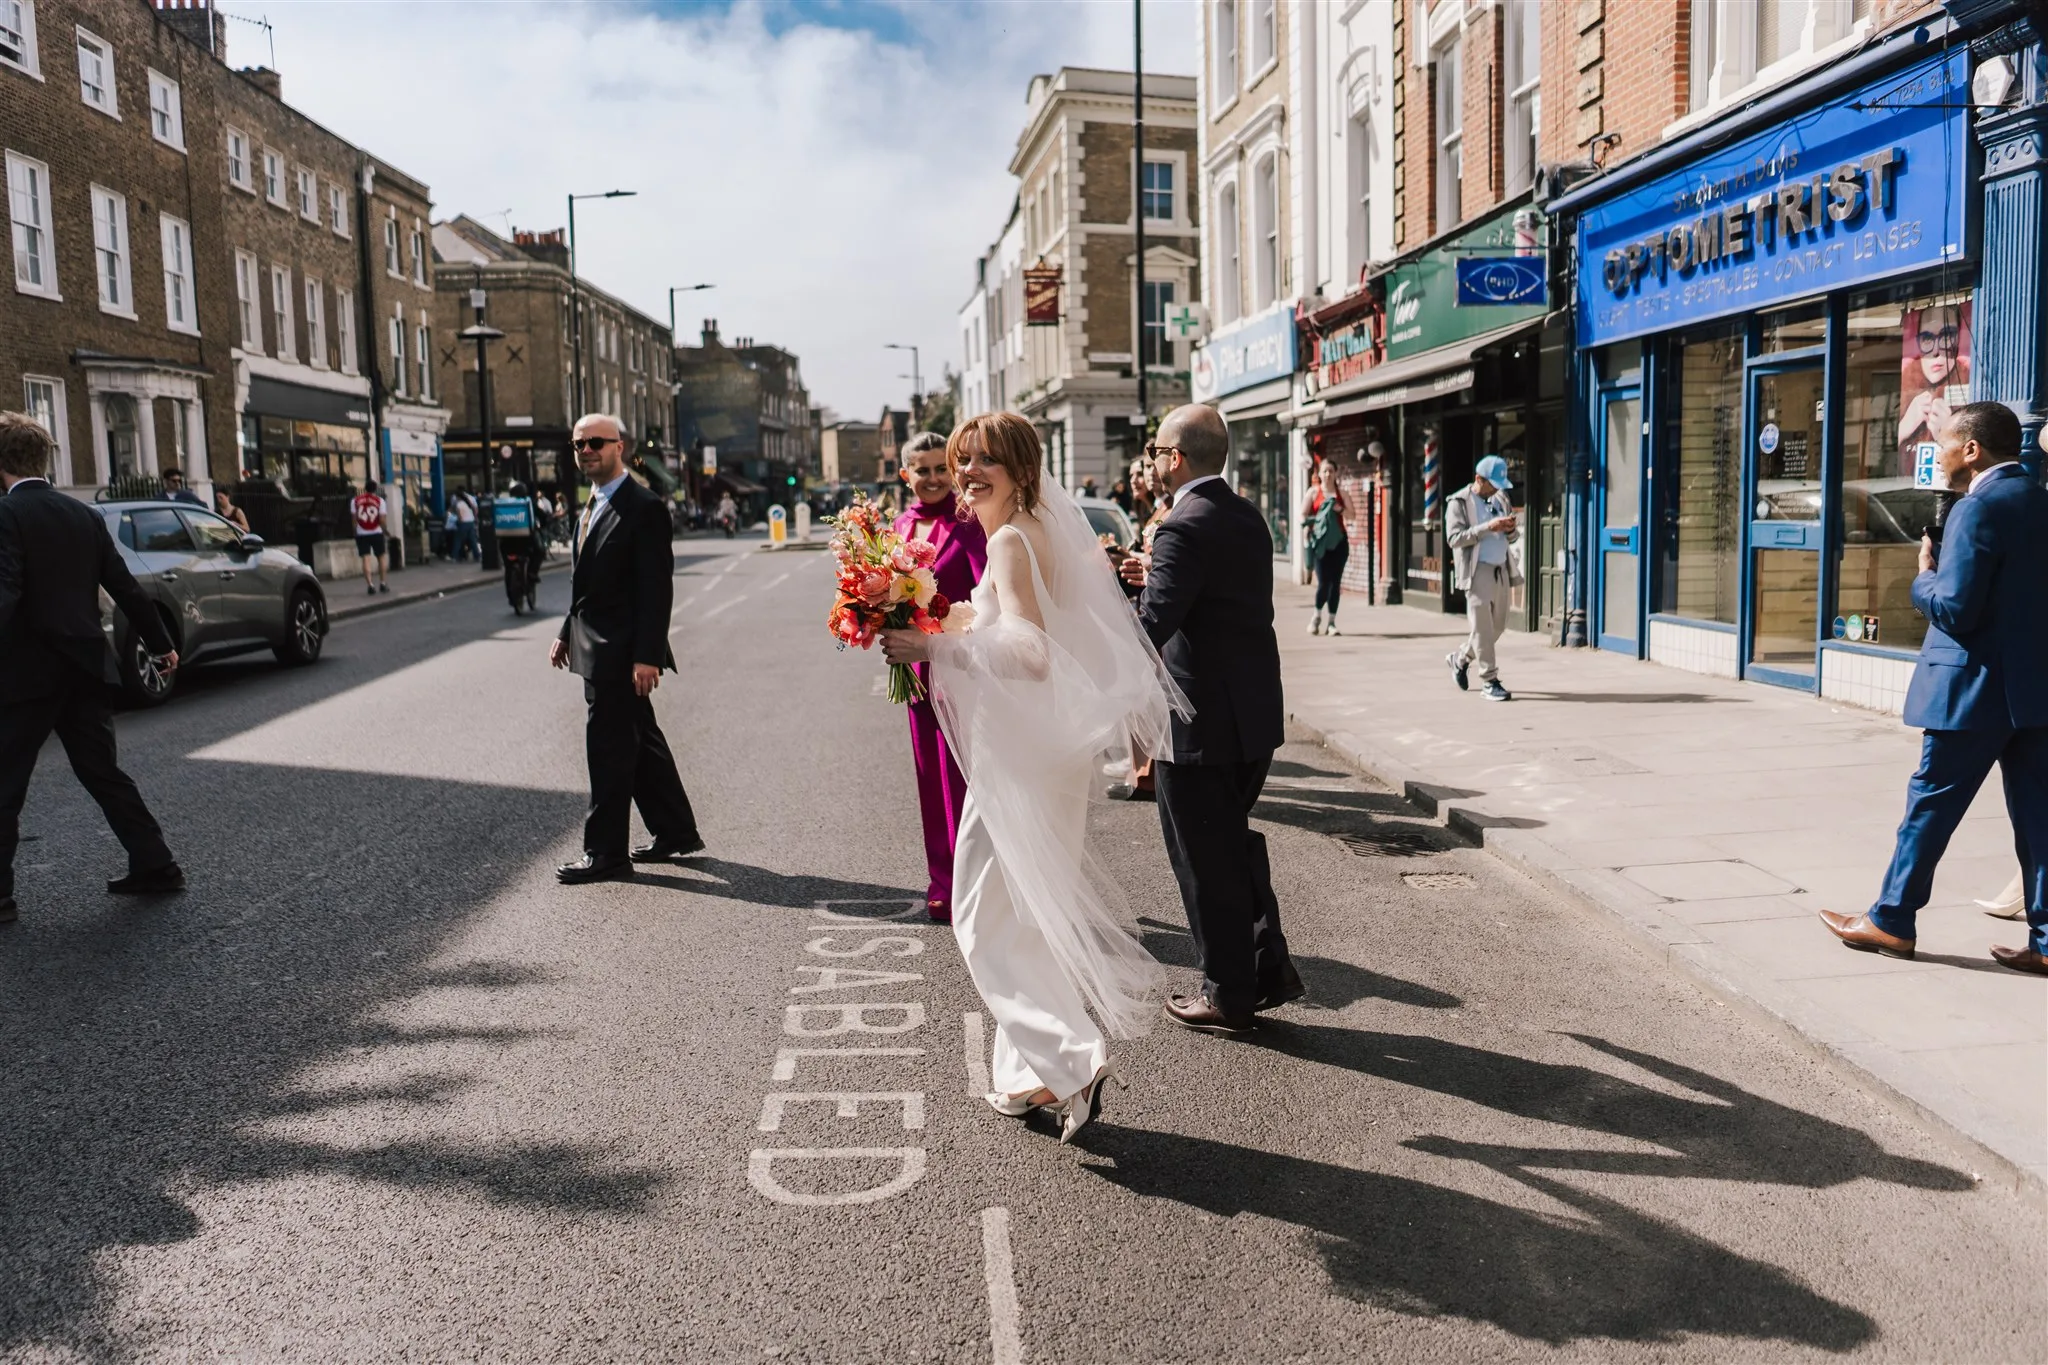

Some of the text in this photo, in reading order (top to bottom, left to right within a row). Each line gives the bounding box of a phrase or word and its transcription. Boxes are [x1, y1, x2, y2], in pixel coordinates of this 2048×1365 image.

[1673, 174, 1729, 213] Stephen
[1755, 147, 1799, 182] Davis
[1603, 147, 1902, 293] OPTOMETRIST
[1683, 264, 1759, 306] SPECTACLES
[1774, 242, 1845, 283] CONTACT
[1853, 220, 1922, 261] LENSES
[1220, 332, 1283, 379] Pharmacy
[358, 504, 379, 524] 49
[748, 900, 926, 1205] DISABLED
